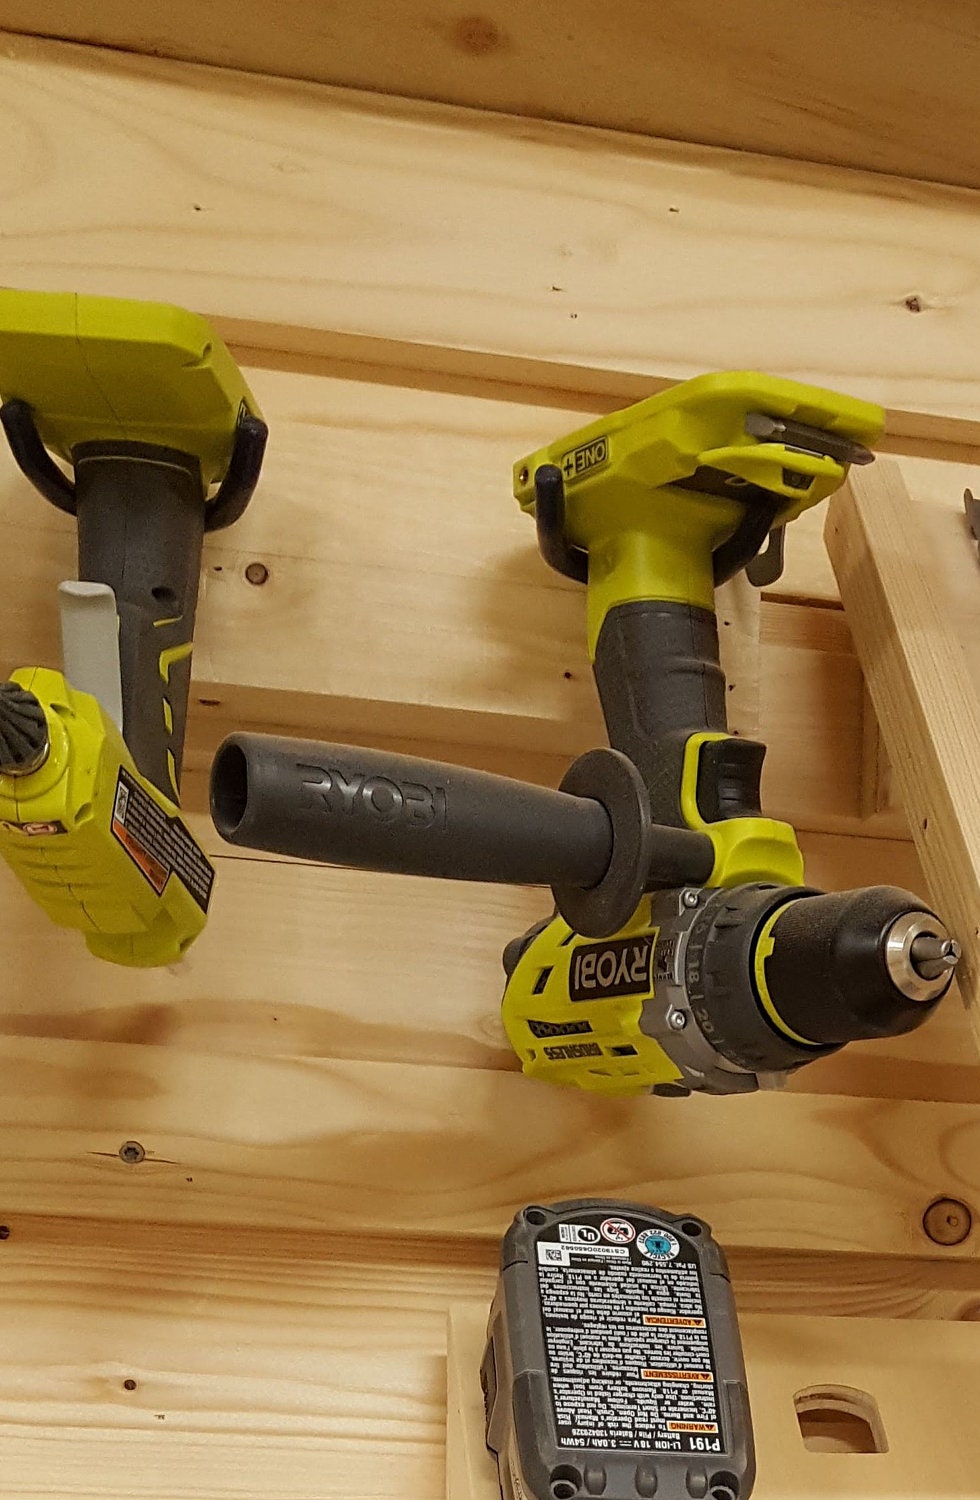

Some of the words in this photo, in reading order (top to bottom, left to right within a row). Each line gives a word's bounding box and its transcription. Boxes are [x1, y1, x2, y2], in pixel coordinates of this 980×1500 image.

[563, 440, 606, 479] ONE+
[296, 763, 447, 831] RYOBI
[574, 945, 648, 989] RYOBI
[689, 961, 699, 984] 18
[646, 1317, 691, 1325] ADVERTENCIA
[644, 1371, 699, 1379] AVERTISSEMENT
[671, 1422, 705, 1430] WARNING
[561, 1437, 584, 1446] 54Wh
[593, 1439, 616, 1447] 3.0Ah
[655, 1441, 681, 1450] LI-ION
[689, 1437, 720, 1451] P191
